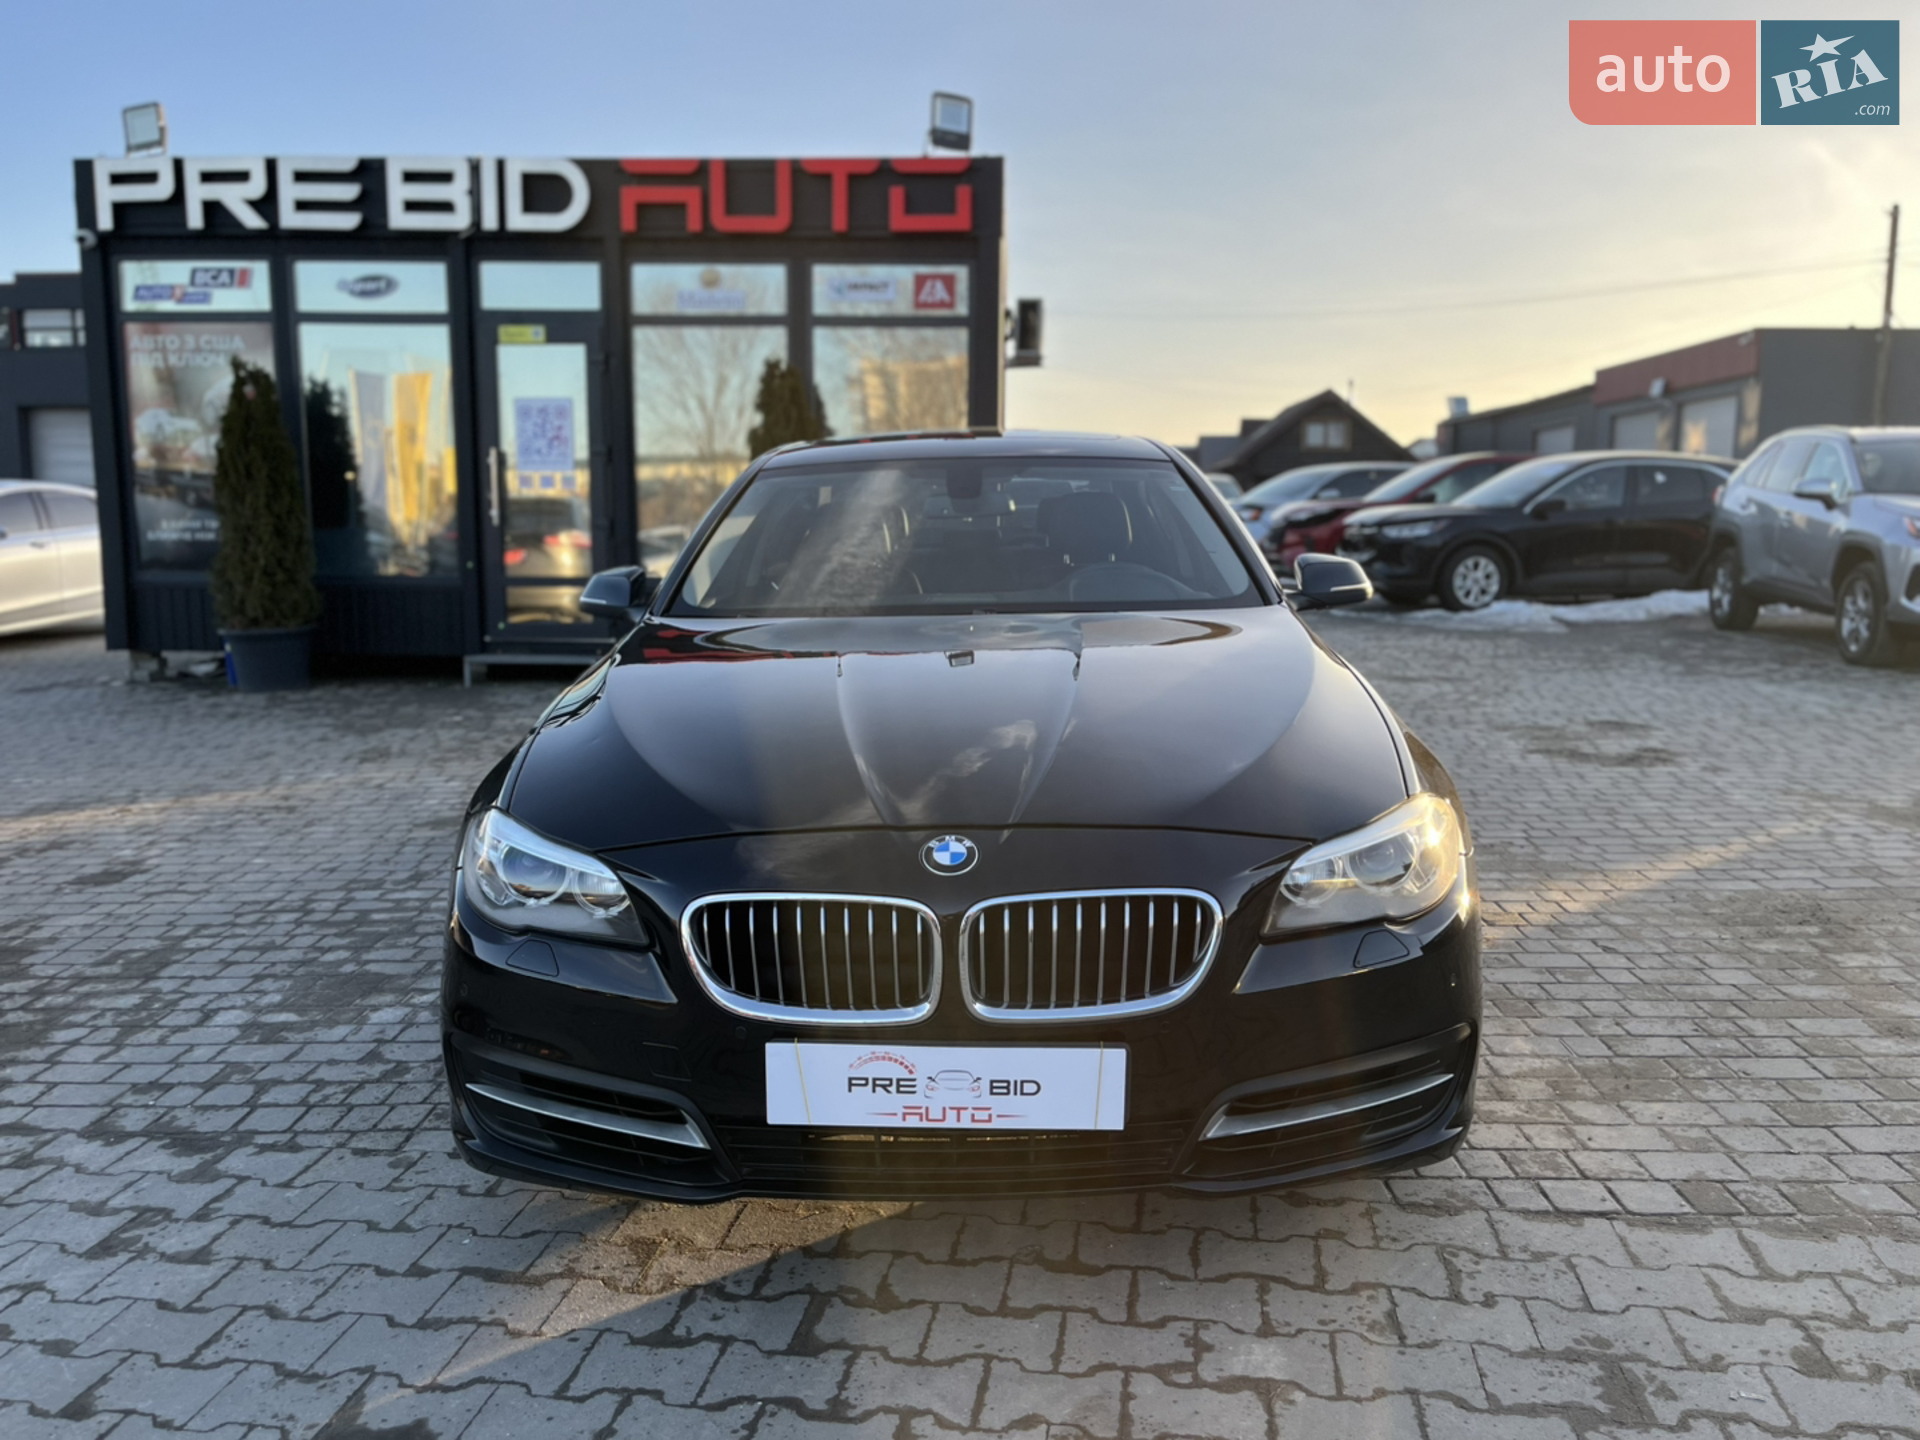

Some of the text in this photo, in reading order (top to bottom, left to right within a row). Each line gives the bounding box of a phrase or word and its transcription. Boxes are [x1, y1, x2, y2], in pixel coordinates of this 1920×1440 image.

[93, 157, 973, 233] PRE BID AUTO
[847, 1076, 1042, 1096] PRE BID
[902, 1105, 992, 1124] AUTO
